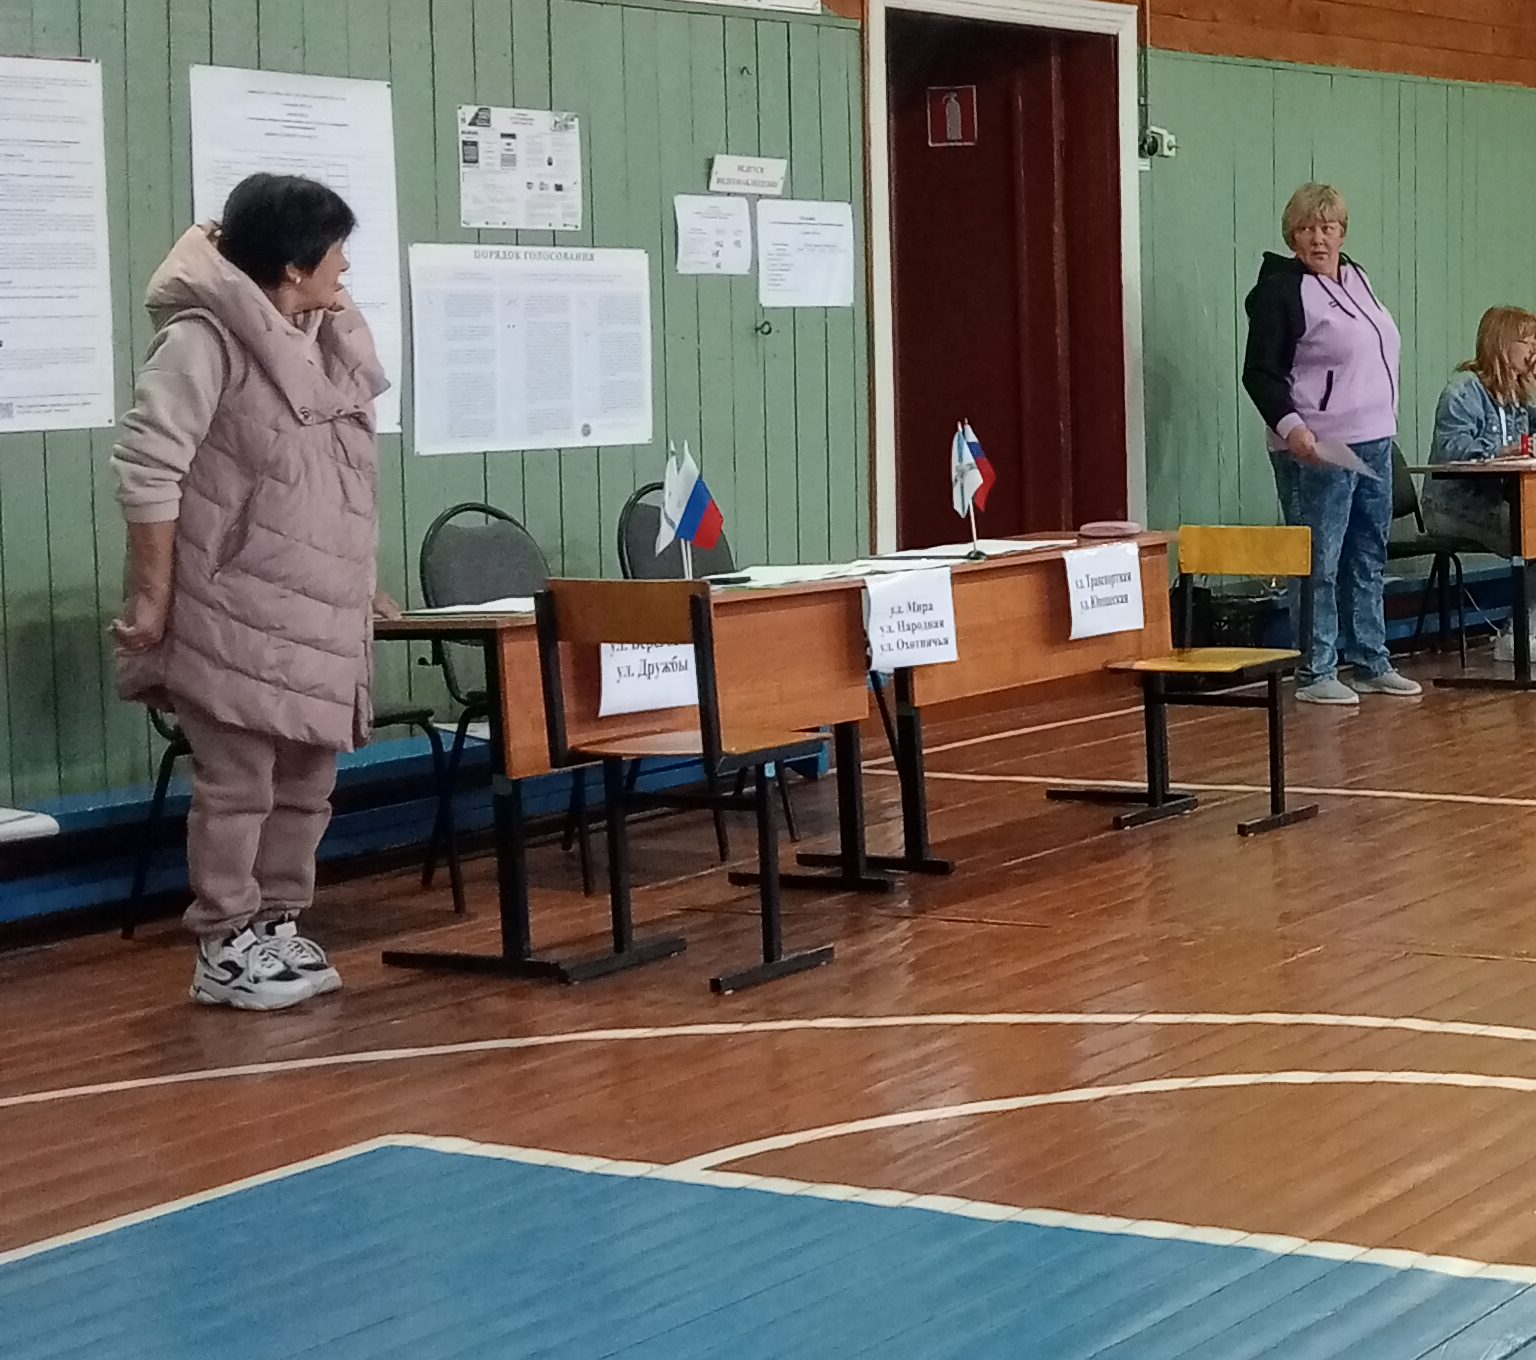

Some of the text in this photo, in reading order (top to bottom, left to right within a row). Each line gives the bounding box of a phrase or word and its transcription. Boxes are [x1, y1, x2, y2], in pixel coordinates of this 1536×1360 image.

[473, 249, 595, 262] ПОРЯДОК ГОЛОСОВАНИЯ
[907, 601, 934, 615] Мира
[897, 619, 944, 634] Народная
[896, 637, 949, 651] Охотничья
[616, 655, 689, 684] ул. Дружбы
